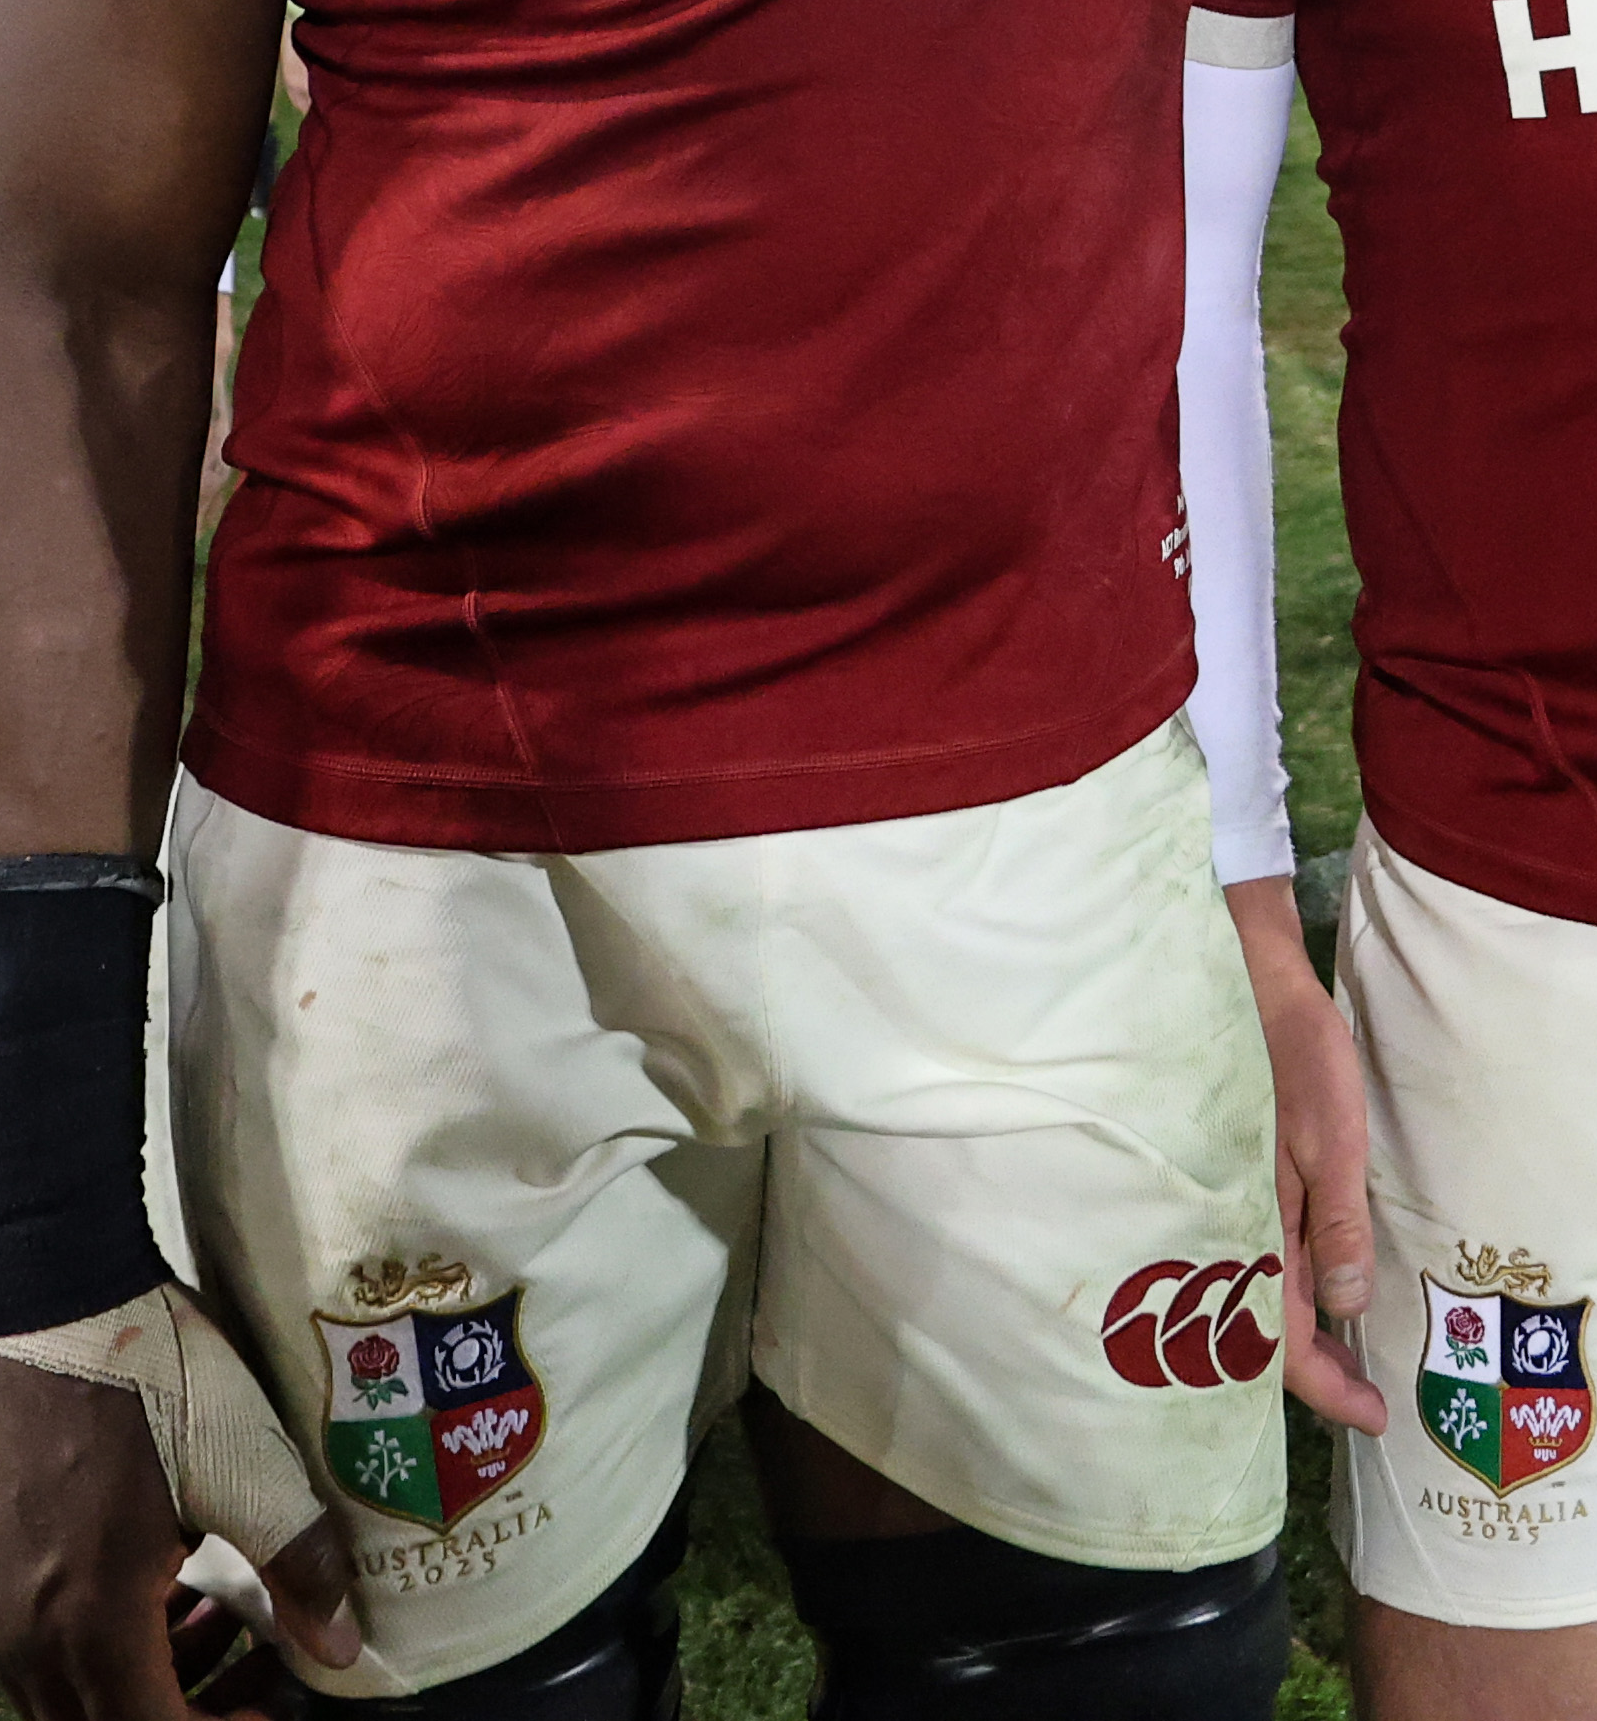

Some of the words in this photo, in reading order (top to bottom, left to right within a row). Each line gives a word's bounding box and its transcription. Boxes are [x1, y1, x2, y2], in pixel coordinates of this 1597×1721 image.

[1418, 1487, 1589, 1524] AUSTRALIA
[363, 1502, 553, 1578] USTRALIA
[1461, 1521, 1541, 1546] 2025
[399, 1548, 497, 1593] 2025
